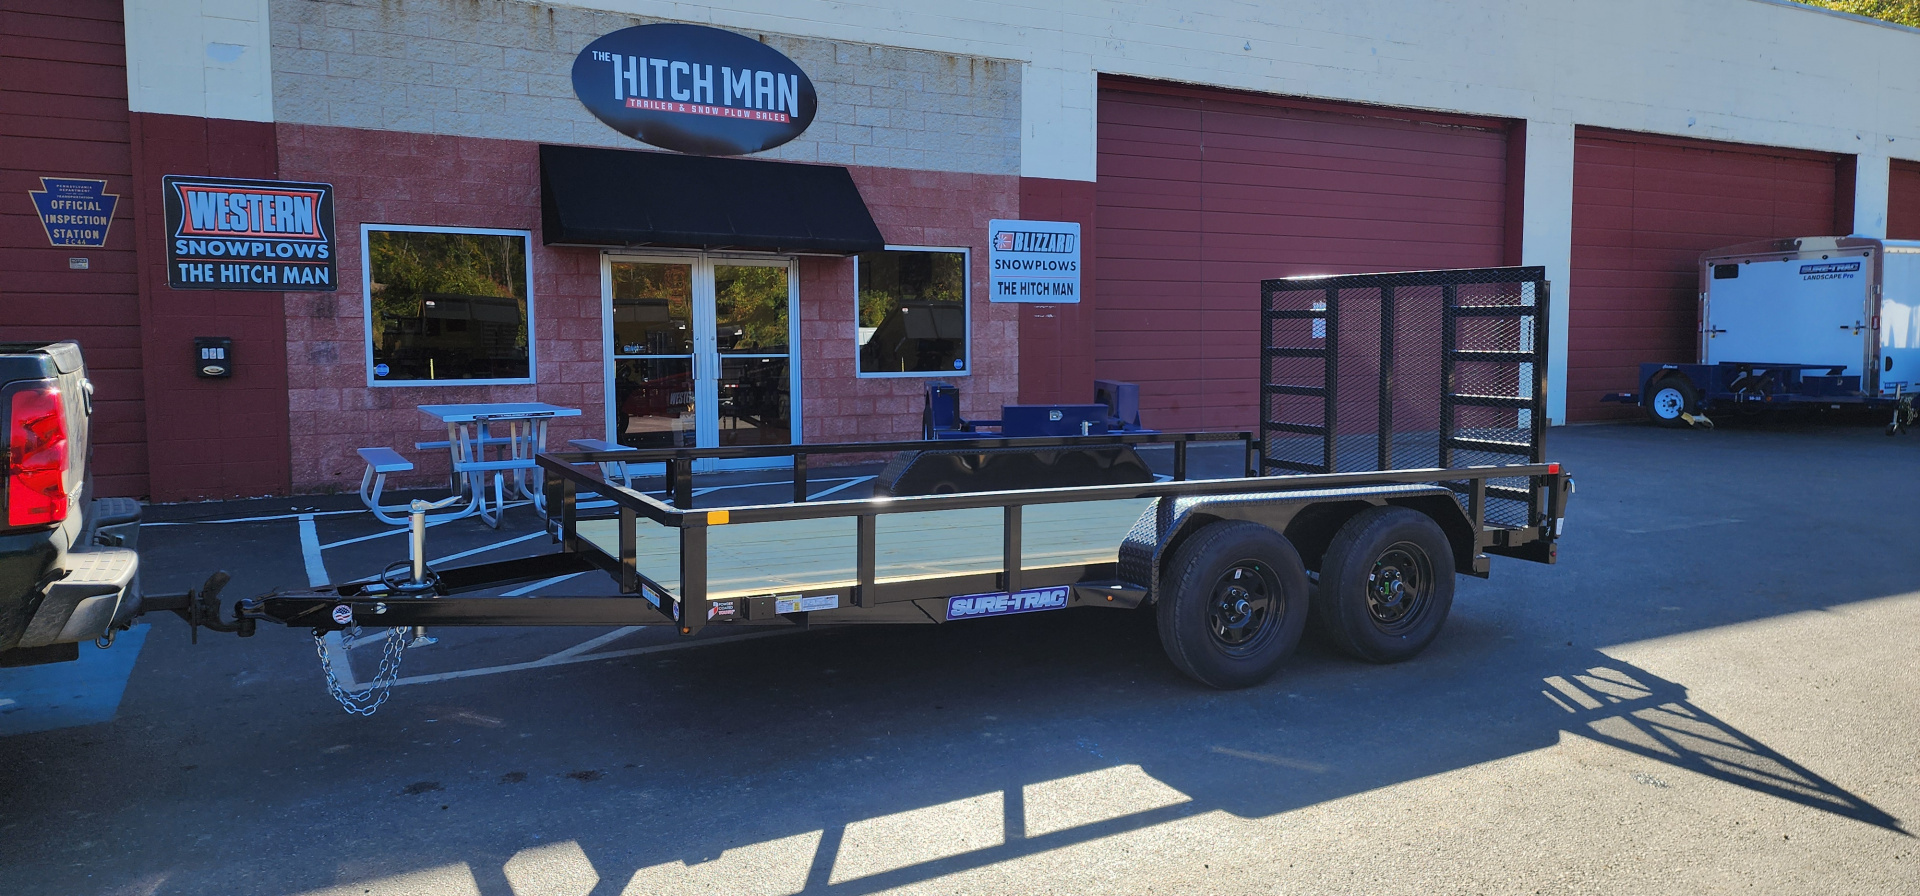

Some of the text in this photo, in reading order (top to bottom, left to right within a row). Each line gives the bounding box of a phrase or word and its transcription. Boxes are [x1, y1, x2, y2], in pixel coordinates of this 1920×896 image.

[592, 50, 799, 118] THE HITCH MAN
[630, 98, 786, 122] TRAILER & SNOW PLOW SALES
[51, 199, 102, 211] OFFICIAL
[187, 190, 313, 233] WESTERN
[45, 214, 107, 225] INSPECTION
[53, 228, 99, 240] STATION
[1014, 232, 1074, 253] BLIZZARD
[175, 240, 329, 259] SNOWPLOWS
[178, 263, 329, 285] THE HITCH MAN
[995, 259, 1076, 271] SNOWPLOWS
[998, 281, 1074, 296] THE HITCH MAN
[951, 589, 1065, 616] SURE-TRAC
